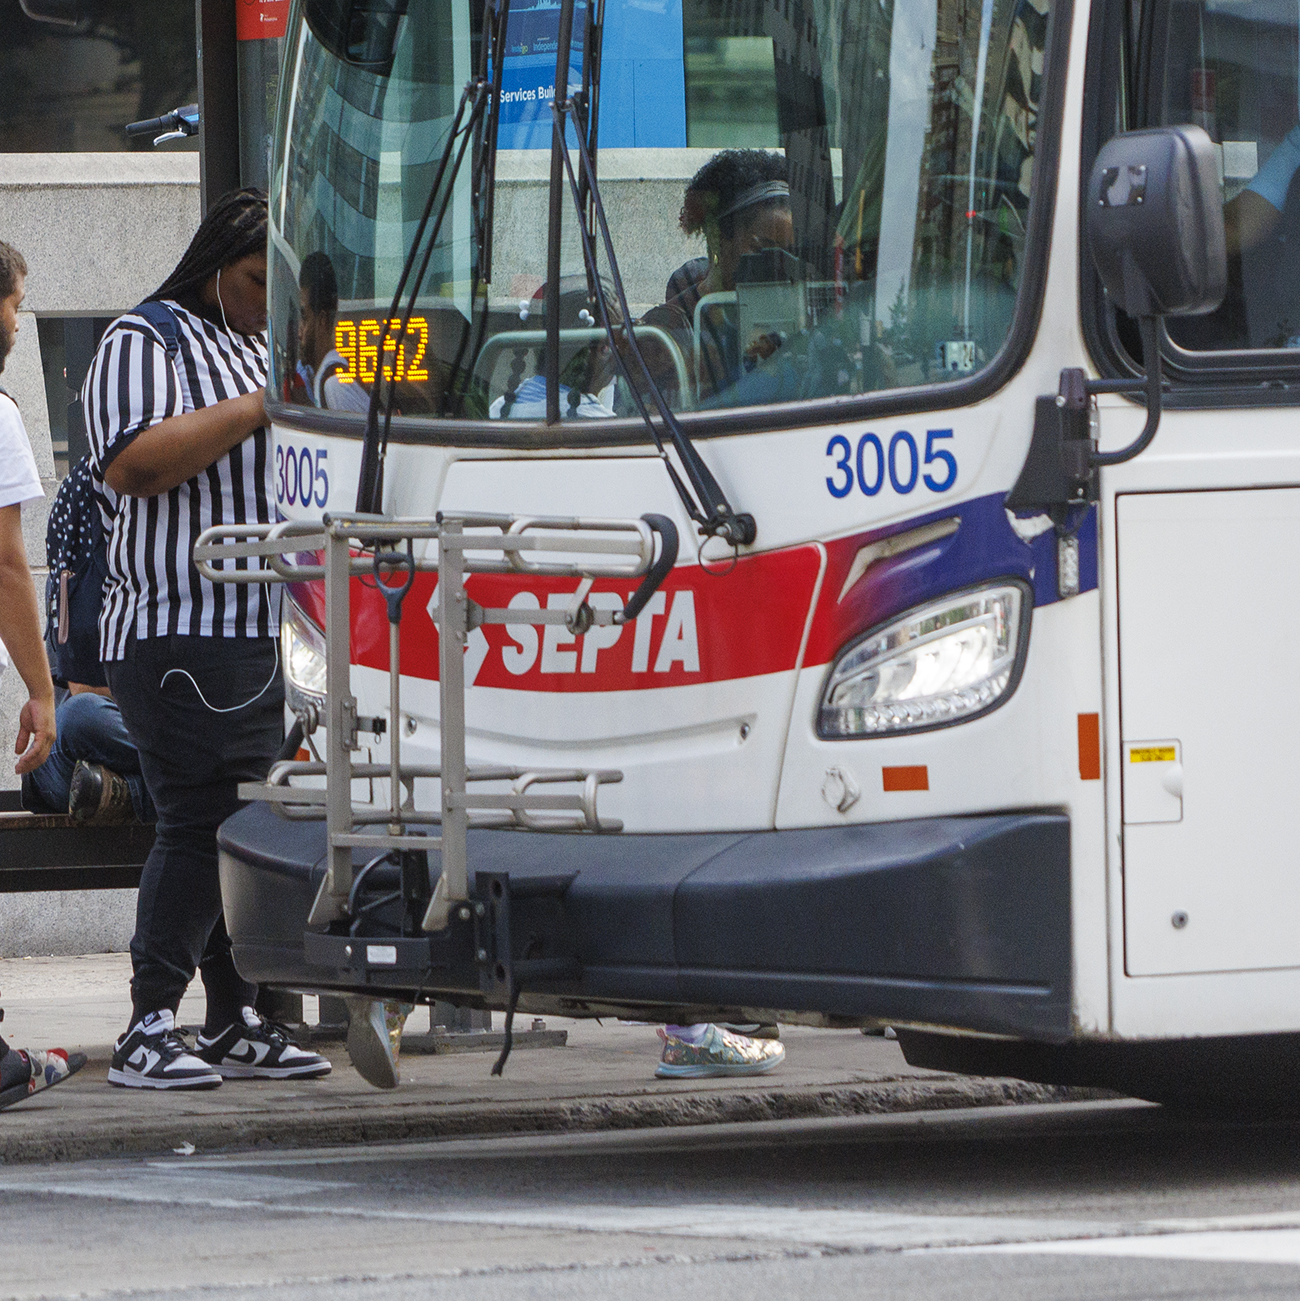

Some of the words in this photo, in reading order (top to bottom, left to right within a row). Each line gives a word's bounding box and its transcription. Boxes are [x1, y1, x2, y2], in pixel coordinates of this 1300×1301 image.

[500, 87, 536, 103] Services
[275, 445, 330, 510] 3005
[825, 428, 959, 499] 3005
[500, 589, 700, 676] SEPTA
